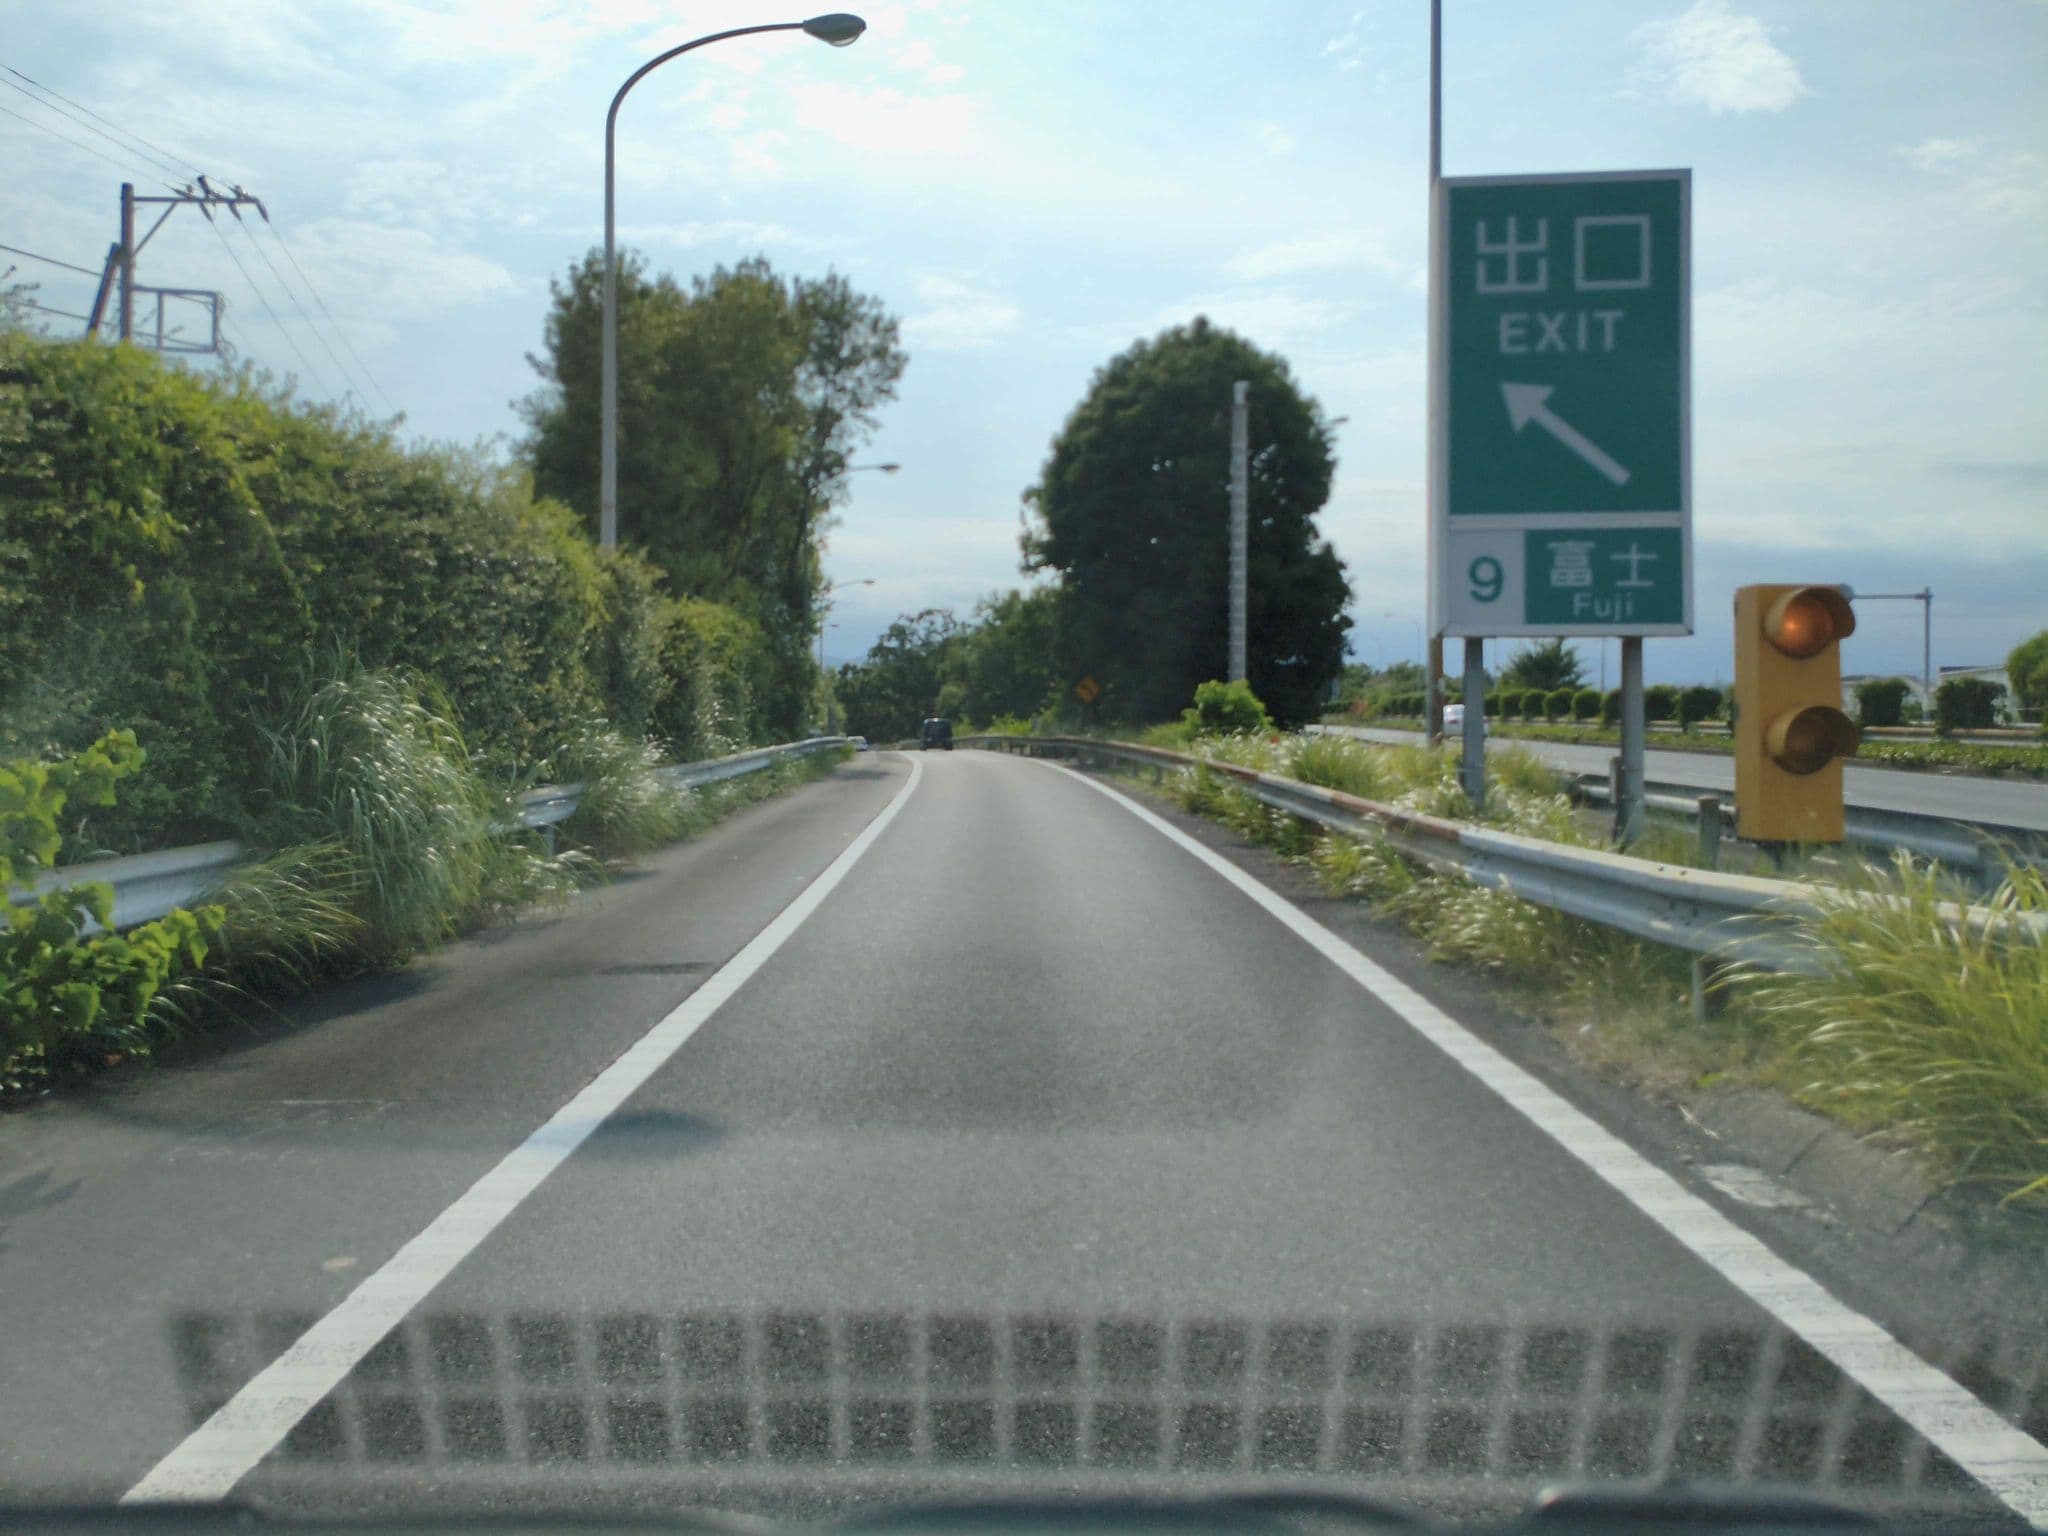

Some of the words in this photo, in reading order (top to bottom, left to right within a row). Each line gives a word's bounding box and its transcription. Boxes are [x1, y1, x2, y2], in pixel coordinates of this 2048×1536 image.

[1476, 215, 1651, 293] 出口
[1500, 311, 1624, 353] EXIT
[1469, 555, 1504, 603] 9
[1547, 540, 1658, 587] 富士
[1573, 591, 1633, 621] Fuji
